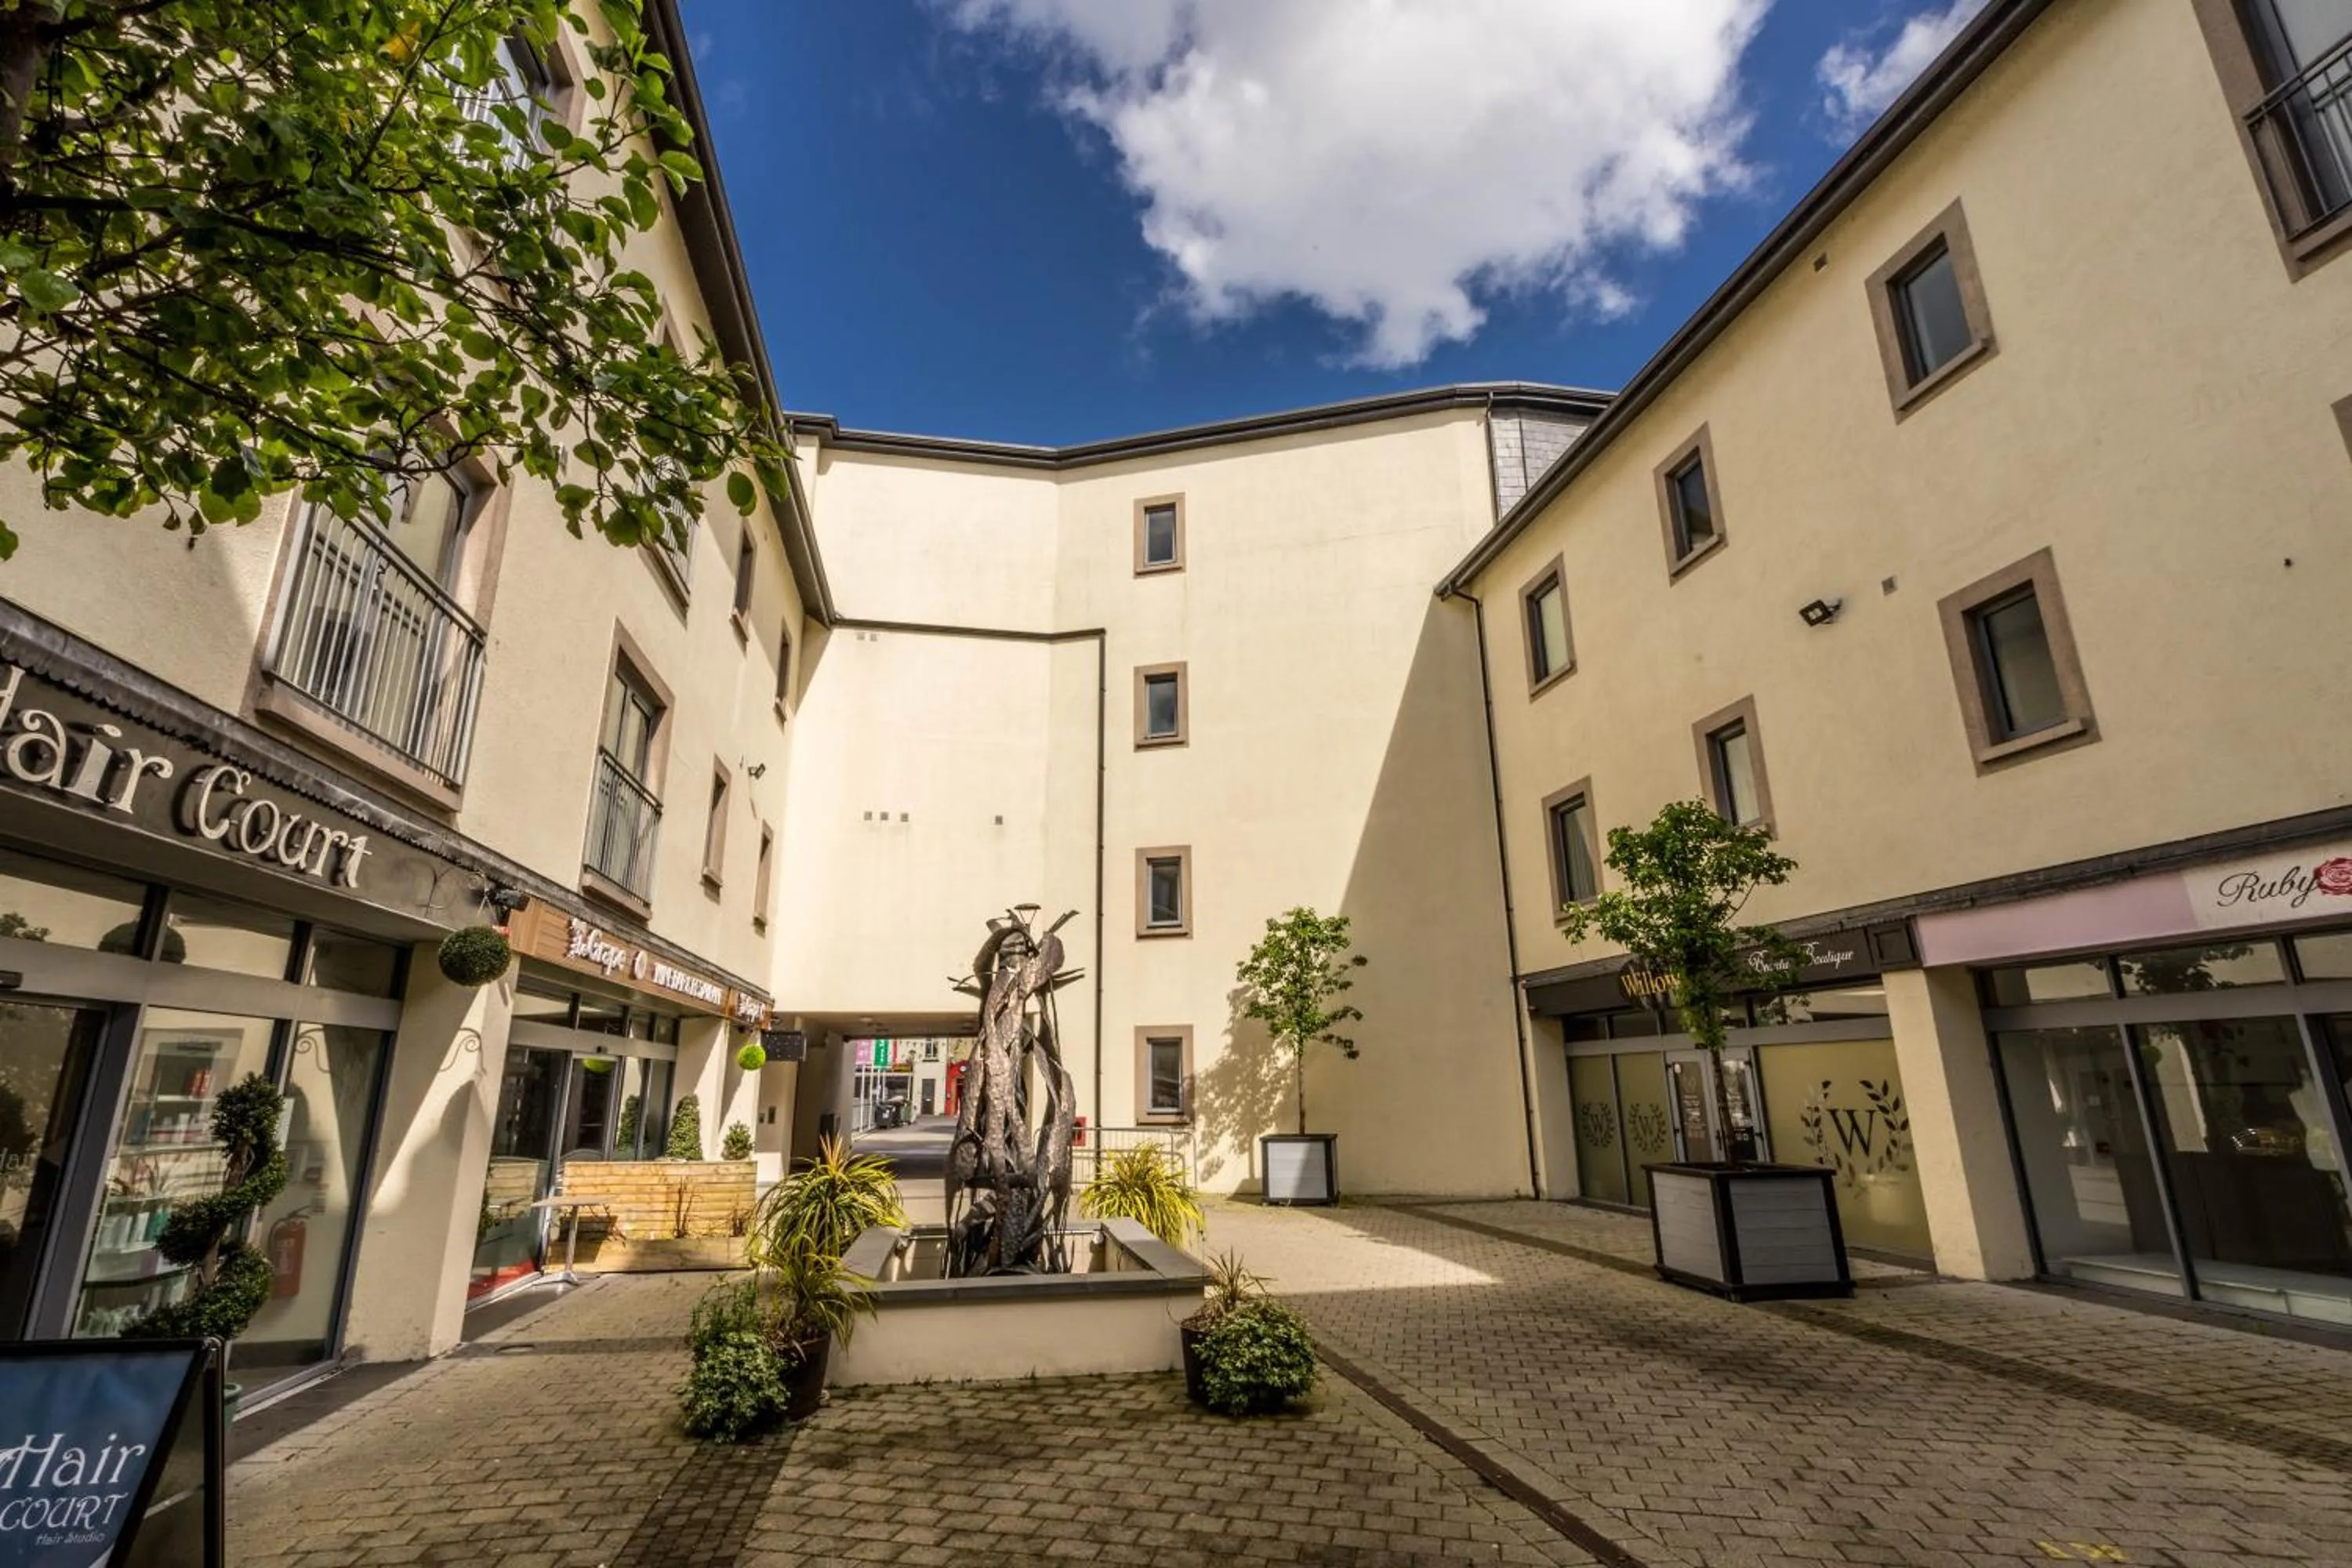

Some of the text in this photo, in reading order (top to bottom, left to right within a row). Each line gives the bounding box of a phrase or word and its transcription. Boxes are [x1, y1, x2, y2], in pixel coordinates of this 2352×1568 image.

[198, 765, 372, 888] Court
[2217, 866, 2318, 909] Ruby
[1827, 1109, 1878, 1157] W
[0, 1433, 147, 1489] Hair
[0, 1492, 129, 1530] COURT
[35, 1530, 106, 1546] Hair Studio
